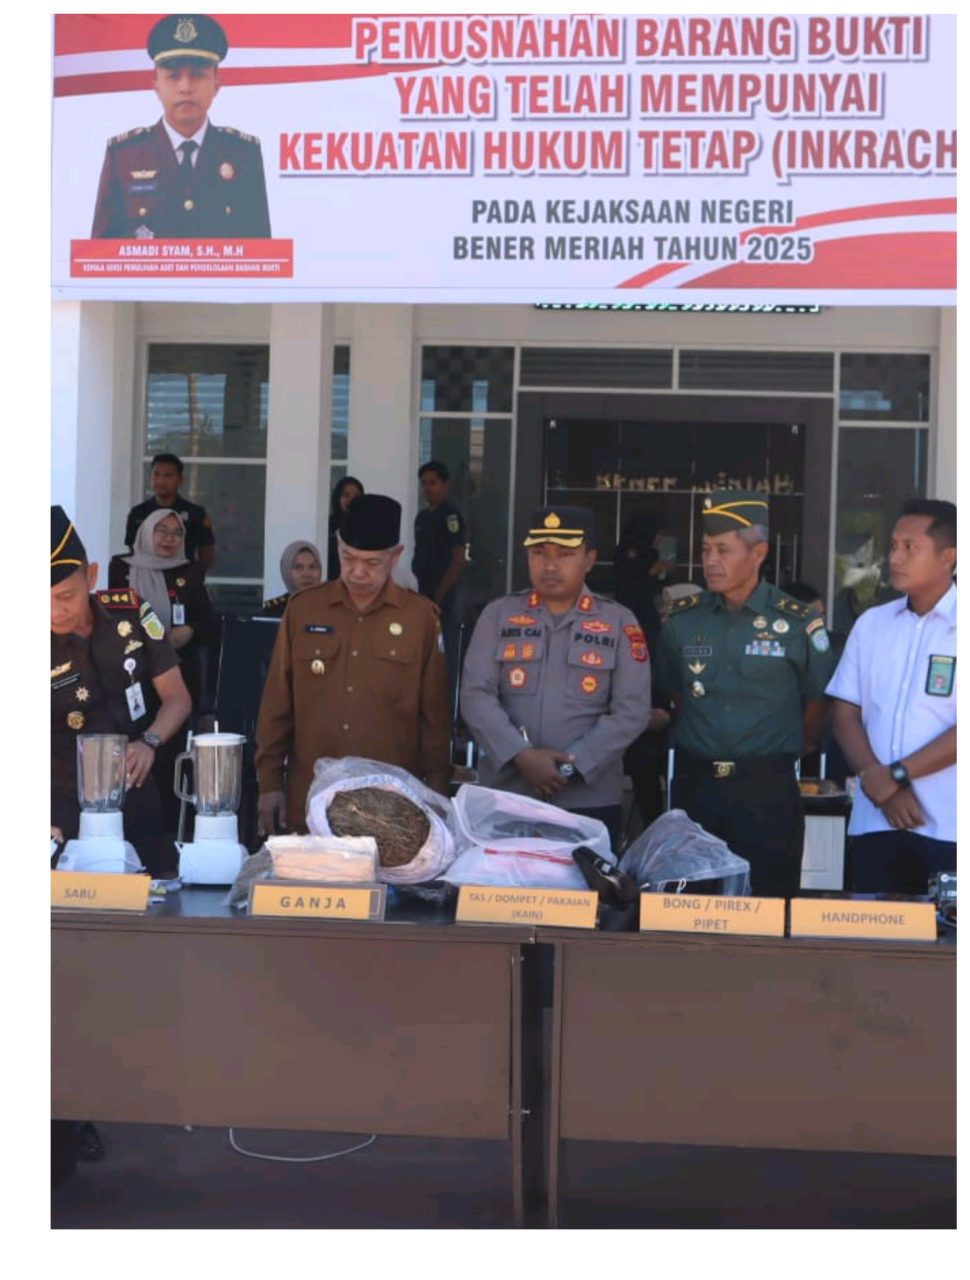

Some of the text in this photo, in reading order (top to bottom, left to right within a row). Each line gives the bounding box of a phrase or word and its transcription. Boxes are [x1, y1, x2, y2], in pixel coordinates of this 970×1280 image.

[355, 16, 924, 60] PEMUSNAHAN BARANG BUKTI
[395, 73, 879, 115] YANG TELAH MEMPUNYAI
[279, 132, 467, 170] KEKUATAN
[484, 131, 623, 169] HUKUM
[638, 130, 757, 169] TETAP
[472, 199, 794, 224] PADA KEJAKSAAN NEGERI
[118, 245, 159, 256] ASMADI
[162, 245, 193, 258] SYAM,
[453, 236, 812, 260] BENER MERIAH TAHUN 2025
[574, 633, 615, 648] POLRI
[64, 888, 97, 900] SABU
[469, 893, 485, 901] TAS
[495, 894, 537, 905] DOMPET
[663, 897, 701, 910] BONG
[714, 900, 752, 912] PIREX
[693, 918, 730, 931] PIPET
[821, 912, 907, 926] HANDPHONE
